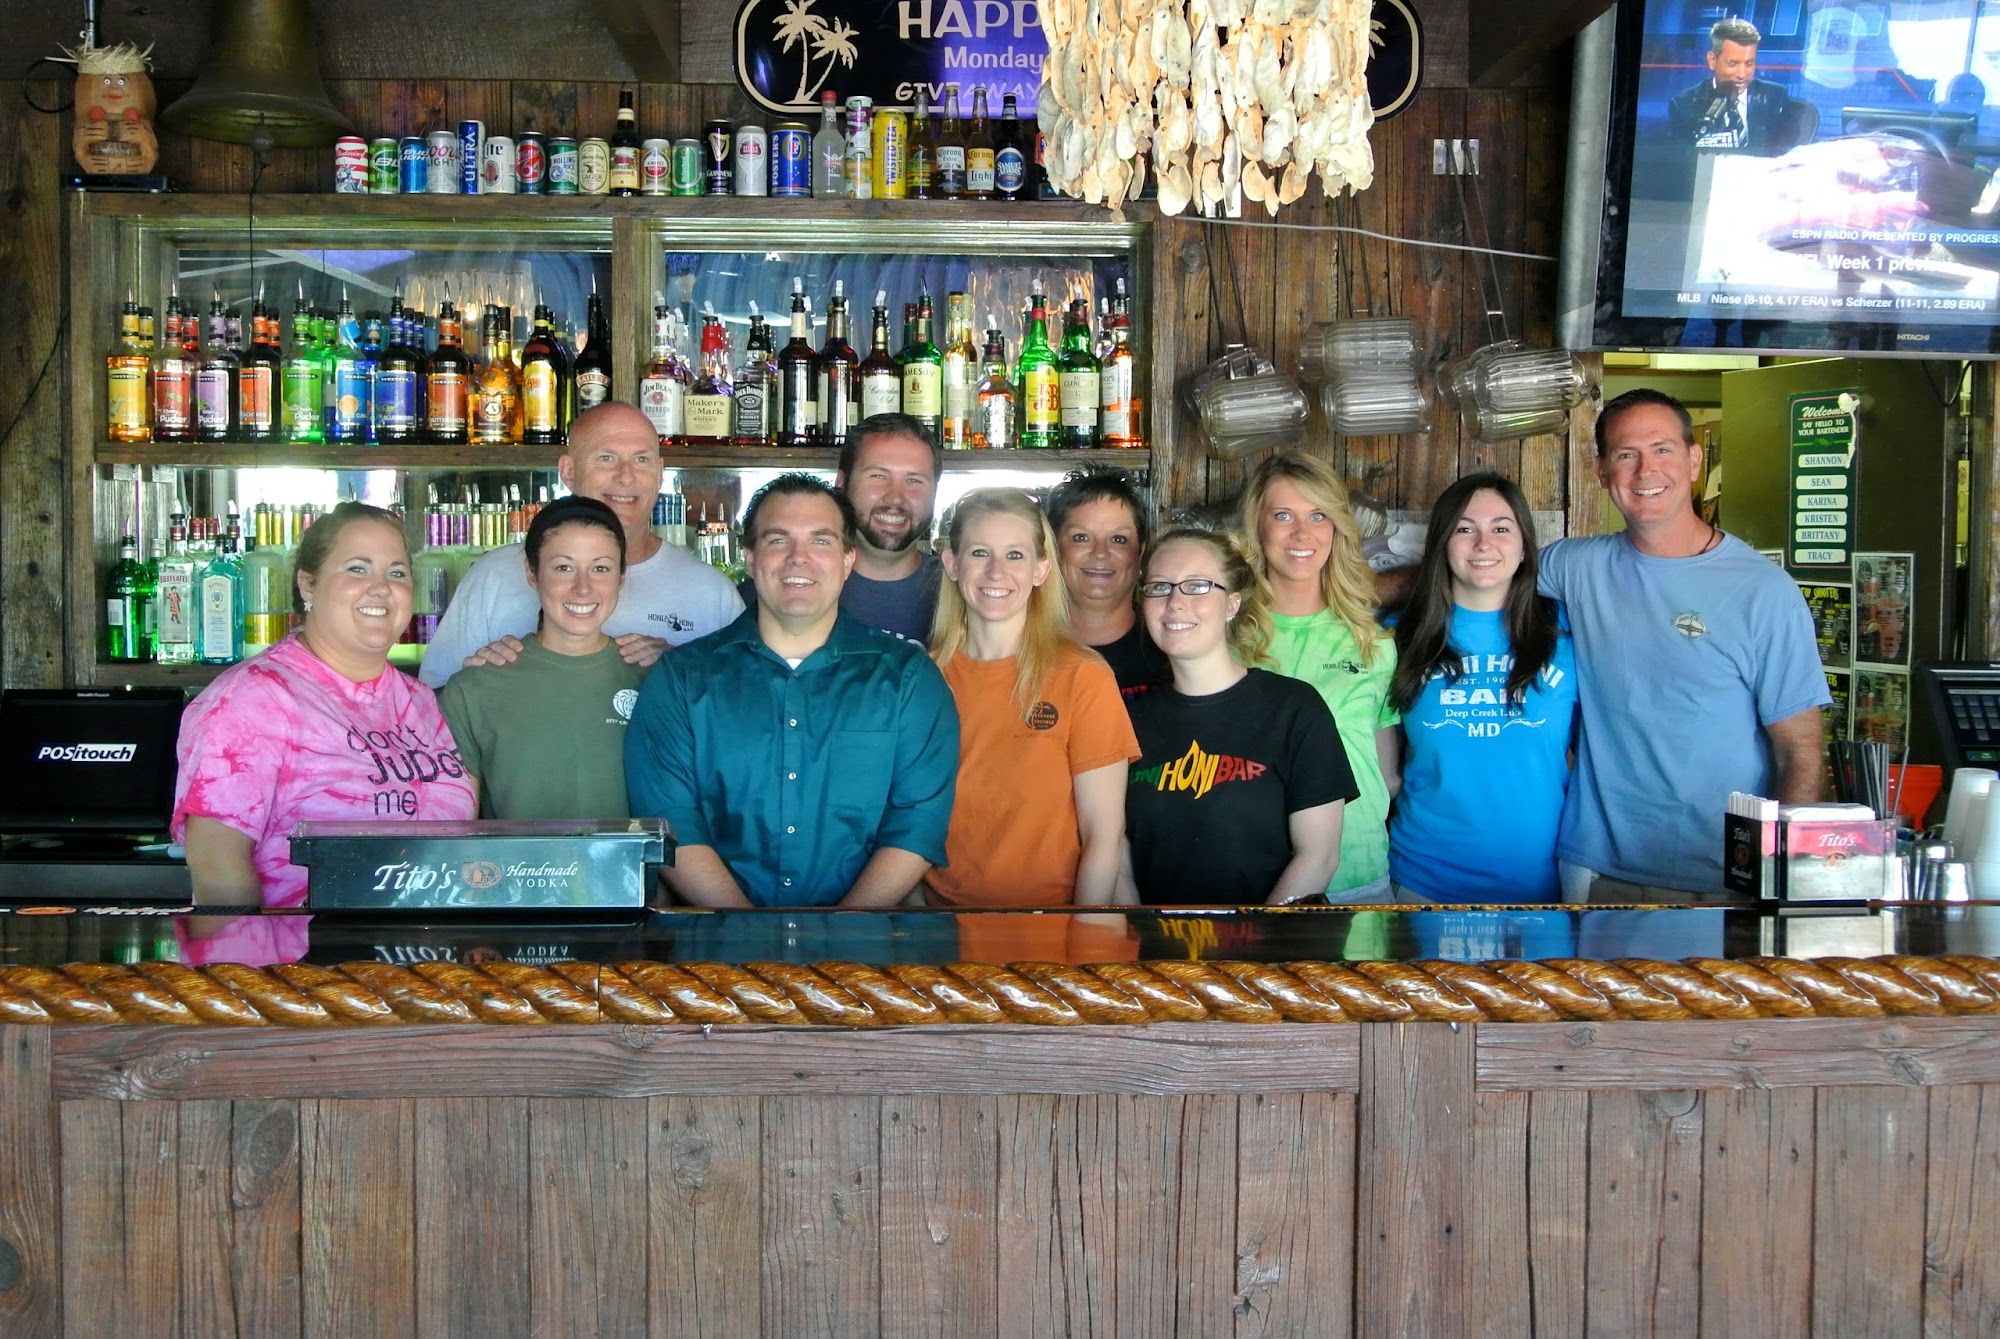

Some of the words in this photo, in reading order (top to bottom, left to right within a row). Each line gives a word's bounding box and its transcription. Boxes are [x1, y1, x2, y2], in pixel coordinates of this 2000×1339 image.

[944, 46, 1044, 74] Monday
[895, 81, 1042, 101] GIVAWAY
[886, 126, 897, 142] TEA
[465, 132, 476, 181] ULTRA
[937, 149, 963, 157] Corona
[967, 150, 993, 160] Corona
[553, 156, 575, 164] ROLLING
[886, 143, 897, 185] TWISTED
[707, 170, 732, 178] GUINNESS
[1792, 230, 1821, 239] ESPN
[1824, 230, 1858, 240] RADIO
[1862, 231, 1925, 242] PRESENTED
[1929, 233, 1943, 242] BY
[1827, 254, 1871, 270] Week
[1876, 256, 1883, 270] 1
[1677, 293, 1701, 303] MLB
[1711, 294, 1741, 304] Niese
[1776, 296, 1799, 306] 4.17
[1802, 296, 1828, 307] ERA)
[1831, 299, 1843, 307] vs
[1846, 297, 1892, 308] Scherzer
[1959, 300, 1985, 311] ERA)
[578, 374, 609, 385] BAILEYS
[524, 378, 555, 393] KAHA
[644, 384, 654, 395] JIM
[687, 399, 725, 407] Maker's
[697, 407, 724, 415] Mark
[160, 414, 187, 423] Pucker
[199, 414, 224, 423] Pucker
[294, 412, 320, 421] Pucker
[1816, 426, 1849, 435] BARTENDER
[1805, 456, 1842, 465] SHANNON
[1811, 478, 1831, 487] SEAN
[1807, 497, 1837, 506] KARINA
[1804, 514, 1838, 523] KRISTEN
[1801, 531, 1840, 540] BRITTANY
[1807, 551, 1833, 560] TRACY
[648, 613, 664, 622] HONI
[680, 619, 694, 627] HONI
[1446, 709, 1468, 718] Deep
[1472, 709, 1497, 717] Creek
[1468, 722, 1500, 738] MD
[347, 724, 429, 752] don't
[38, 746, 131, 760] POSitouch
[1157, 740, 1220, 799] HONI
[1214, 755, 1267, 786] BAR
[373, 789, 417, 816] me
[1818, 832, 1856, 847] Tito's
[373, 861, 457, 891] Tito's
[506, 861, 578, 877] Handmade
[516, 879, 568, 887] VODKA
